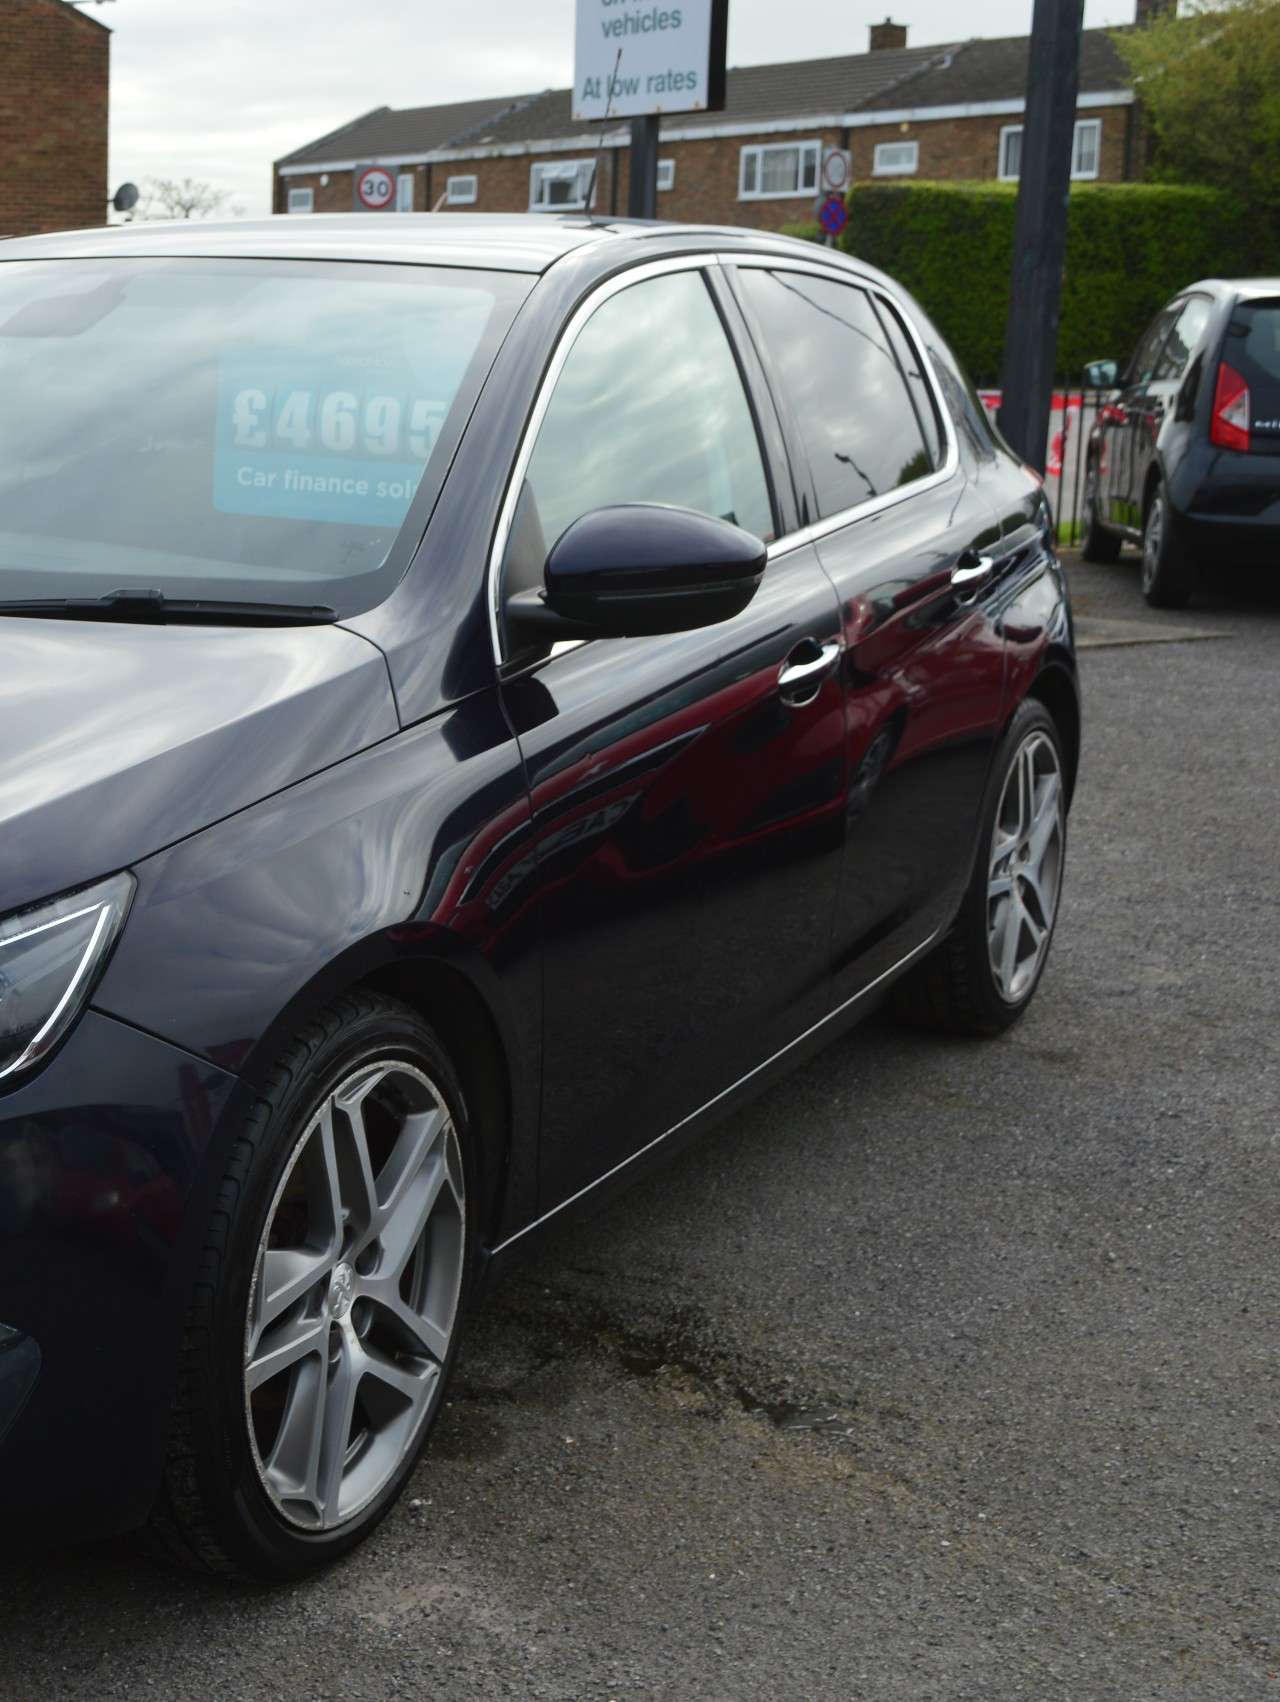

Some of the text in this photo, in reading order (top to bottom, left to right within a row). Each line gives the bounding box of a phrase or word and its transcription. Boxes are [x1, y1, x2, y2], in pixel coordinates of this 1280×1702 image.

[602, 8, 682, 38] vehicles
[582, 69, 697, 100] At low rates
[364, 180, 389, 197] 30
[237, 466, 277, 488] Car
[284, 469, 368, 495] finance
